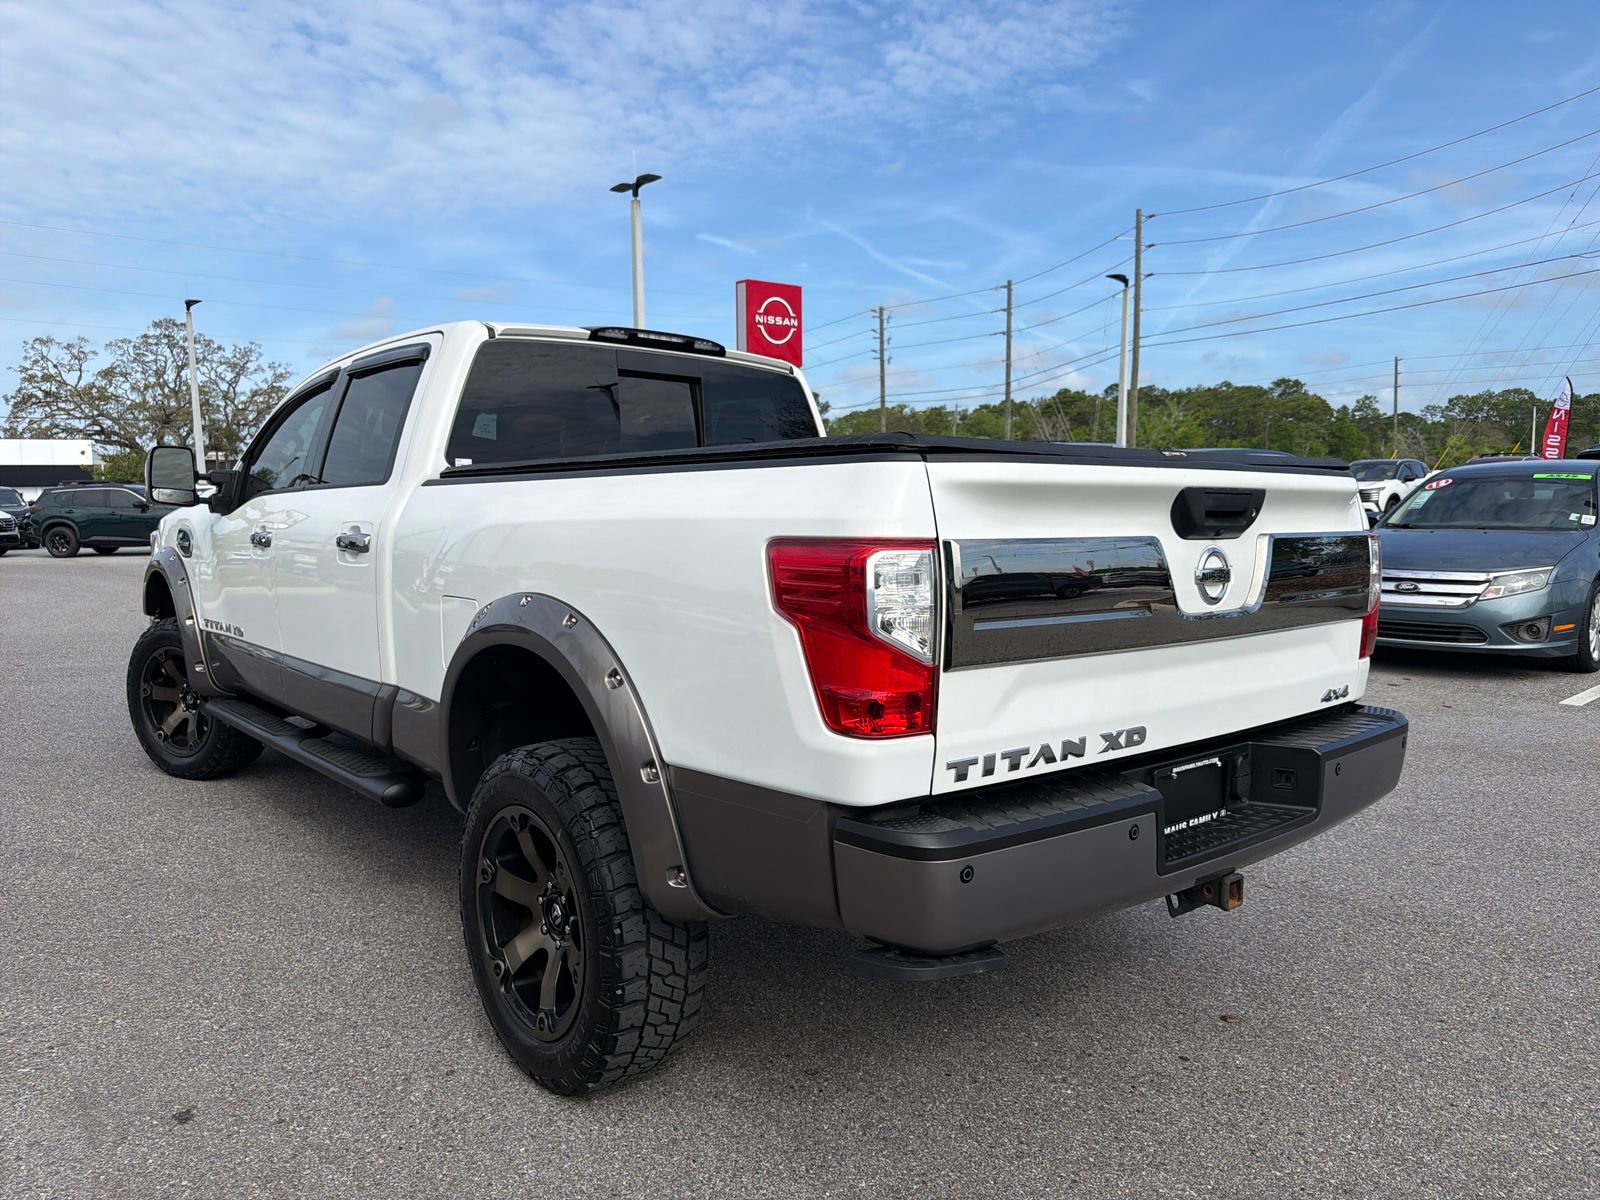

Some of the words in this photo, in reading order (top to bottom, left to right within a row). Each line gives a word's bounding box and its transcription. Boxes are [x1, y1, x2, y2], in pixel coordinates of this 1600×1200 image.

[755, 314, 798, 327] NISSAN
[204, 618, 232, 635] TITAN
[232, 624, 244, 638] XD
[946, 736, 1087, 782] TITAN
[1097, 725, 1147, 754] XD
